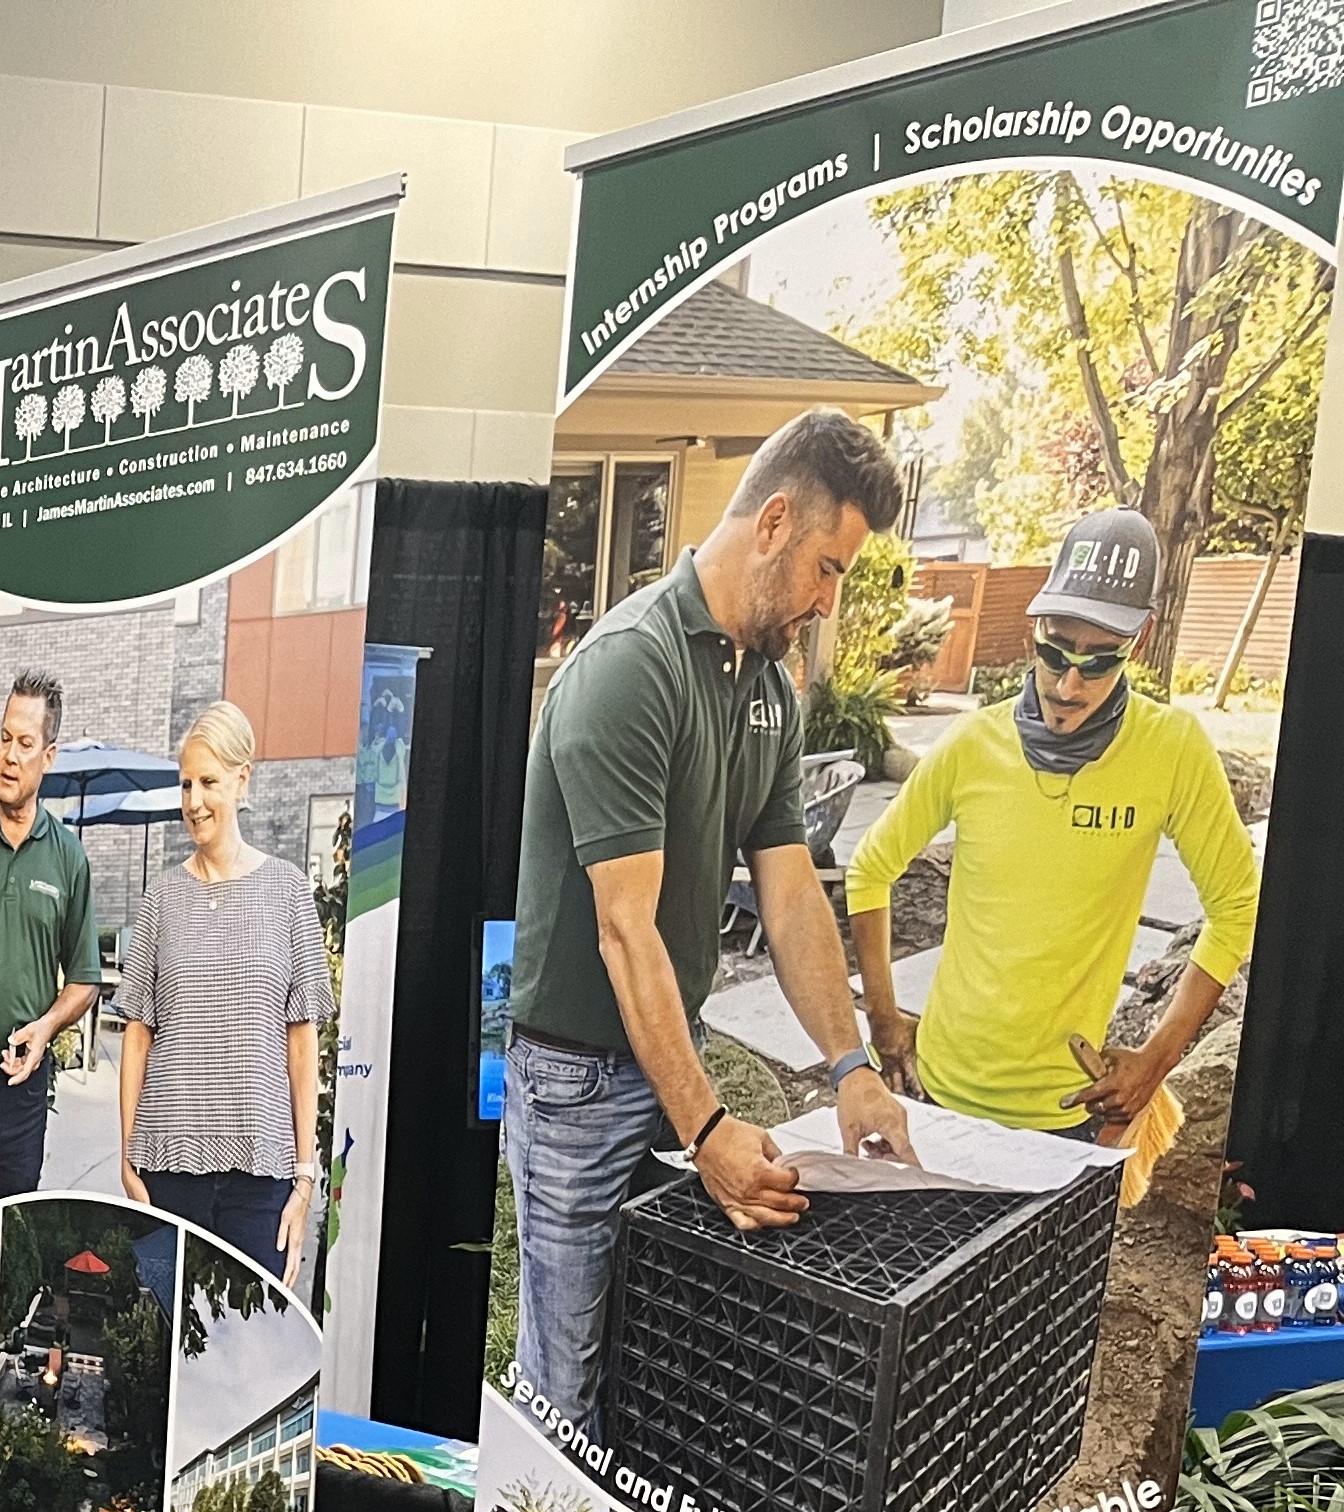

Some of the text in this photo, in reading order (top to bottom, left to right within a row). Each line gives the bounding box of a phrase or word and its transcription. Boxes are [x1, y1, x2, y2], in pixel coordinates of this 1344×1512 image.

[581, 100, 1322, 356] Internship Programs Scholarship Opportunities
[2, 512, 13, 528] IL
[36, 477, 215, 523] JamesMartinAssociates.com
[245, 451, 347, 485] 847.634.1660
[13, 467, 101, 497] Architecture
[118, 443, 218, 476] Construction
[240, 418, 350, 453] Maintenance
[500, 1360, 614, 1477] Seasonal
